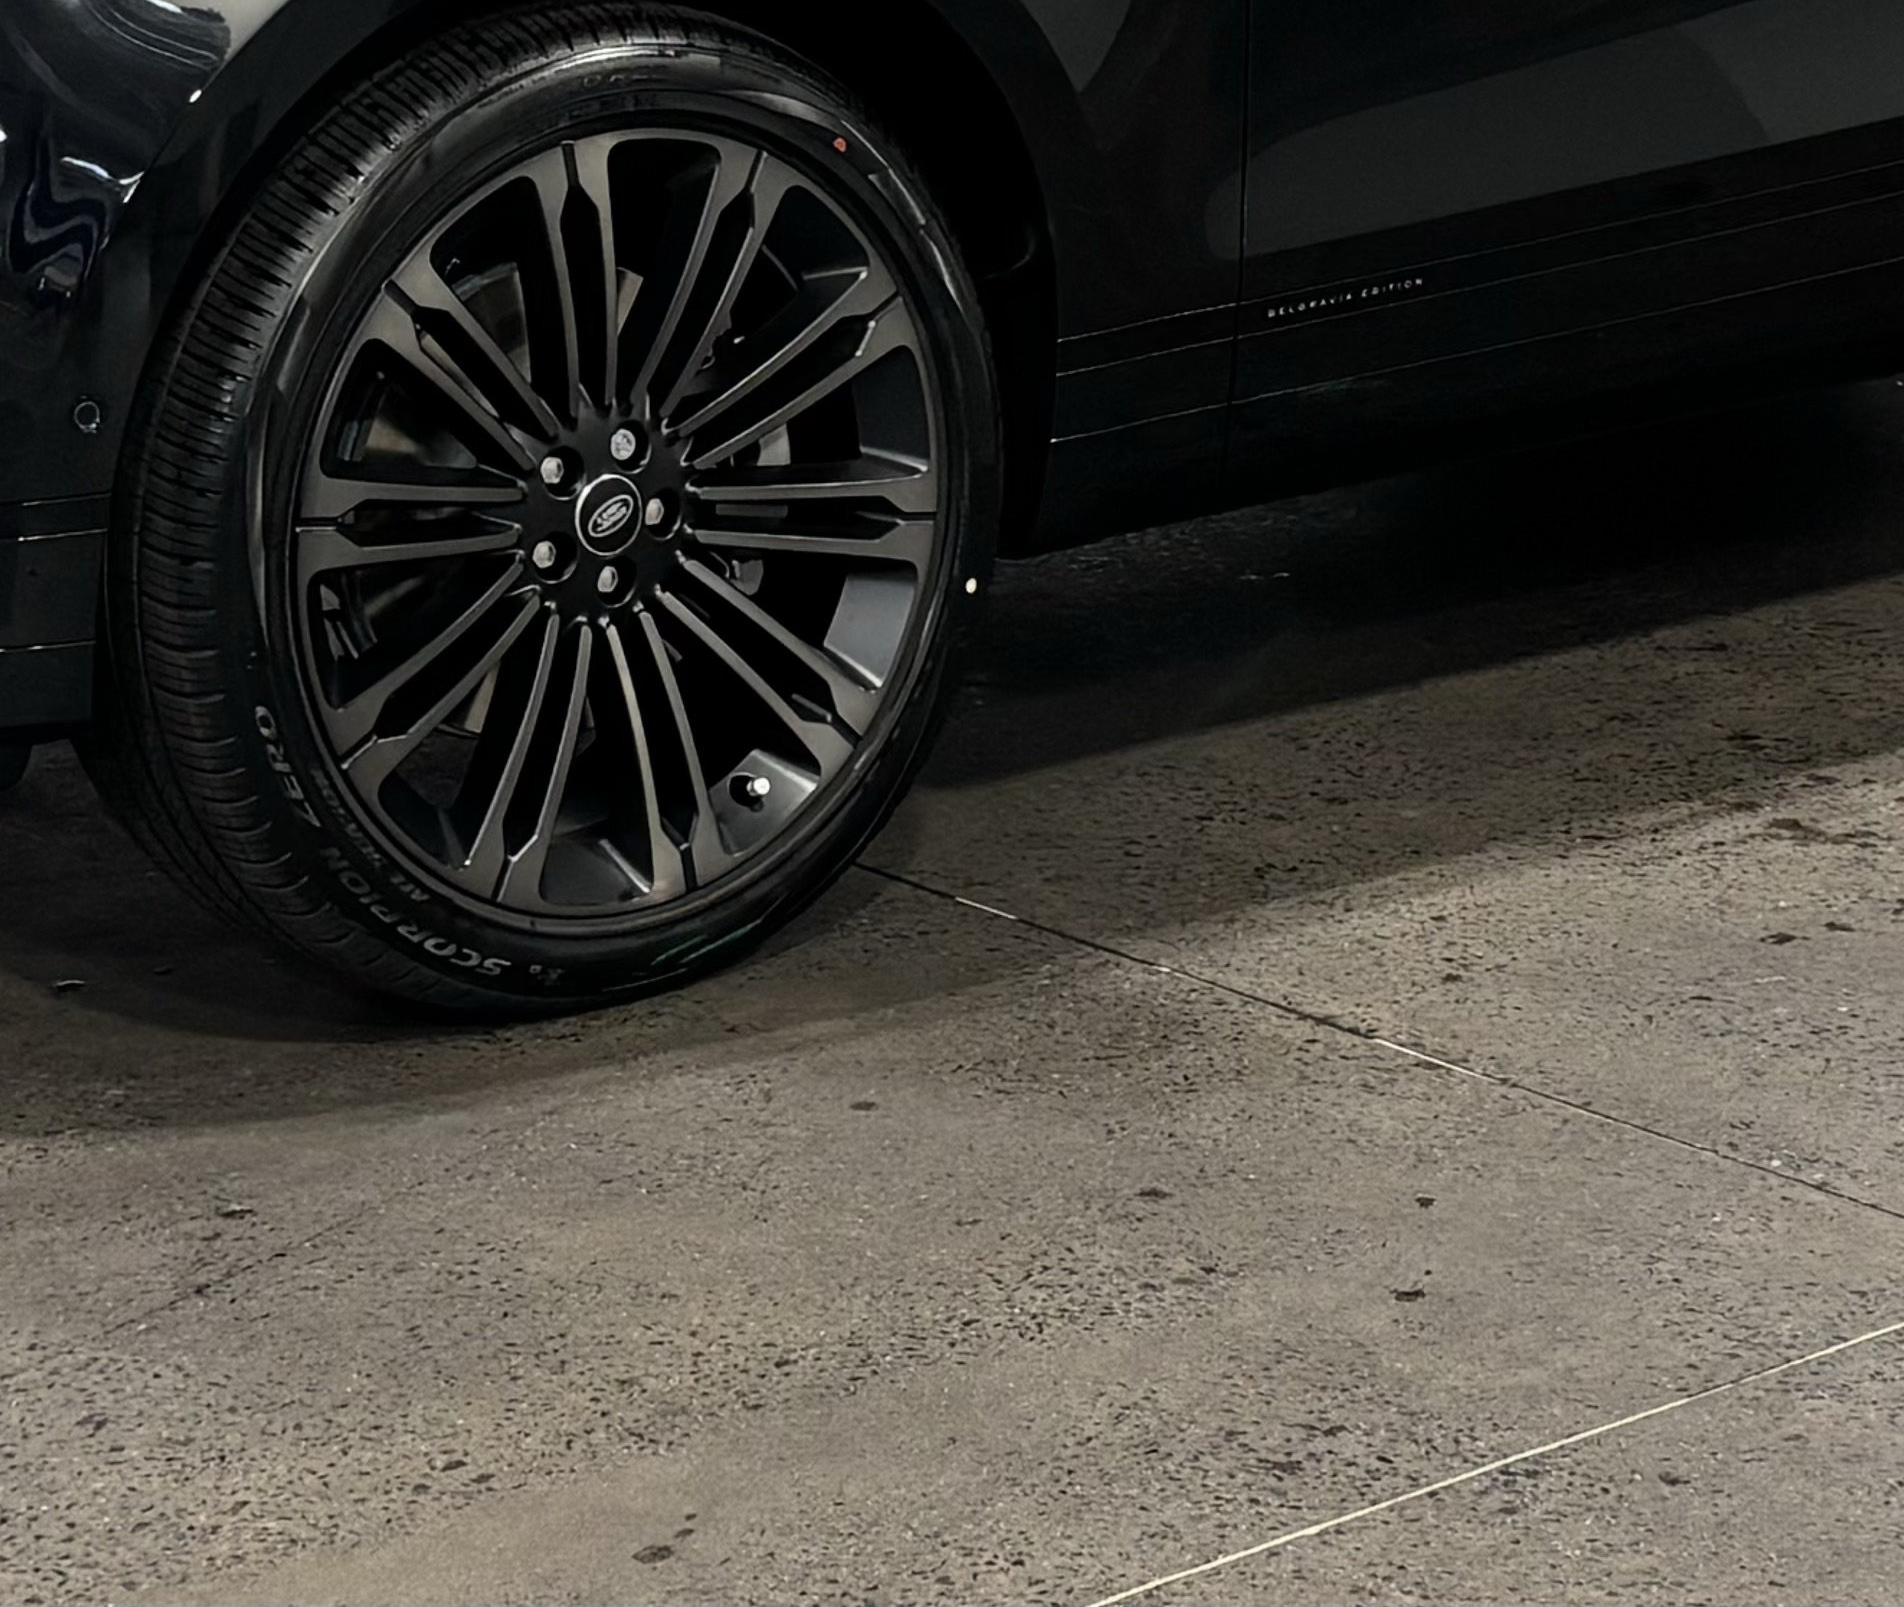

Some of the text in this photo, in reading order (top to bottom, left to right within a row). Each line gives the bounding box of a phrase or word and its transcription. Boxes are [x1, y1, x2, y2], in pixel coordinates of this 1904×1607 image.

[1361, 278, 1423, 297] EDITION
[253, 704, 512, 977] SCORPION ZERO
